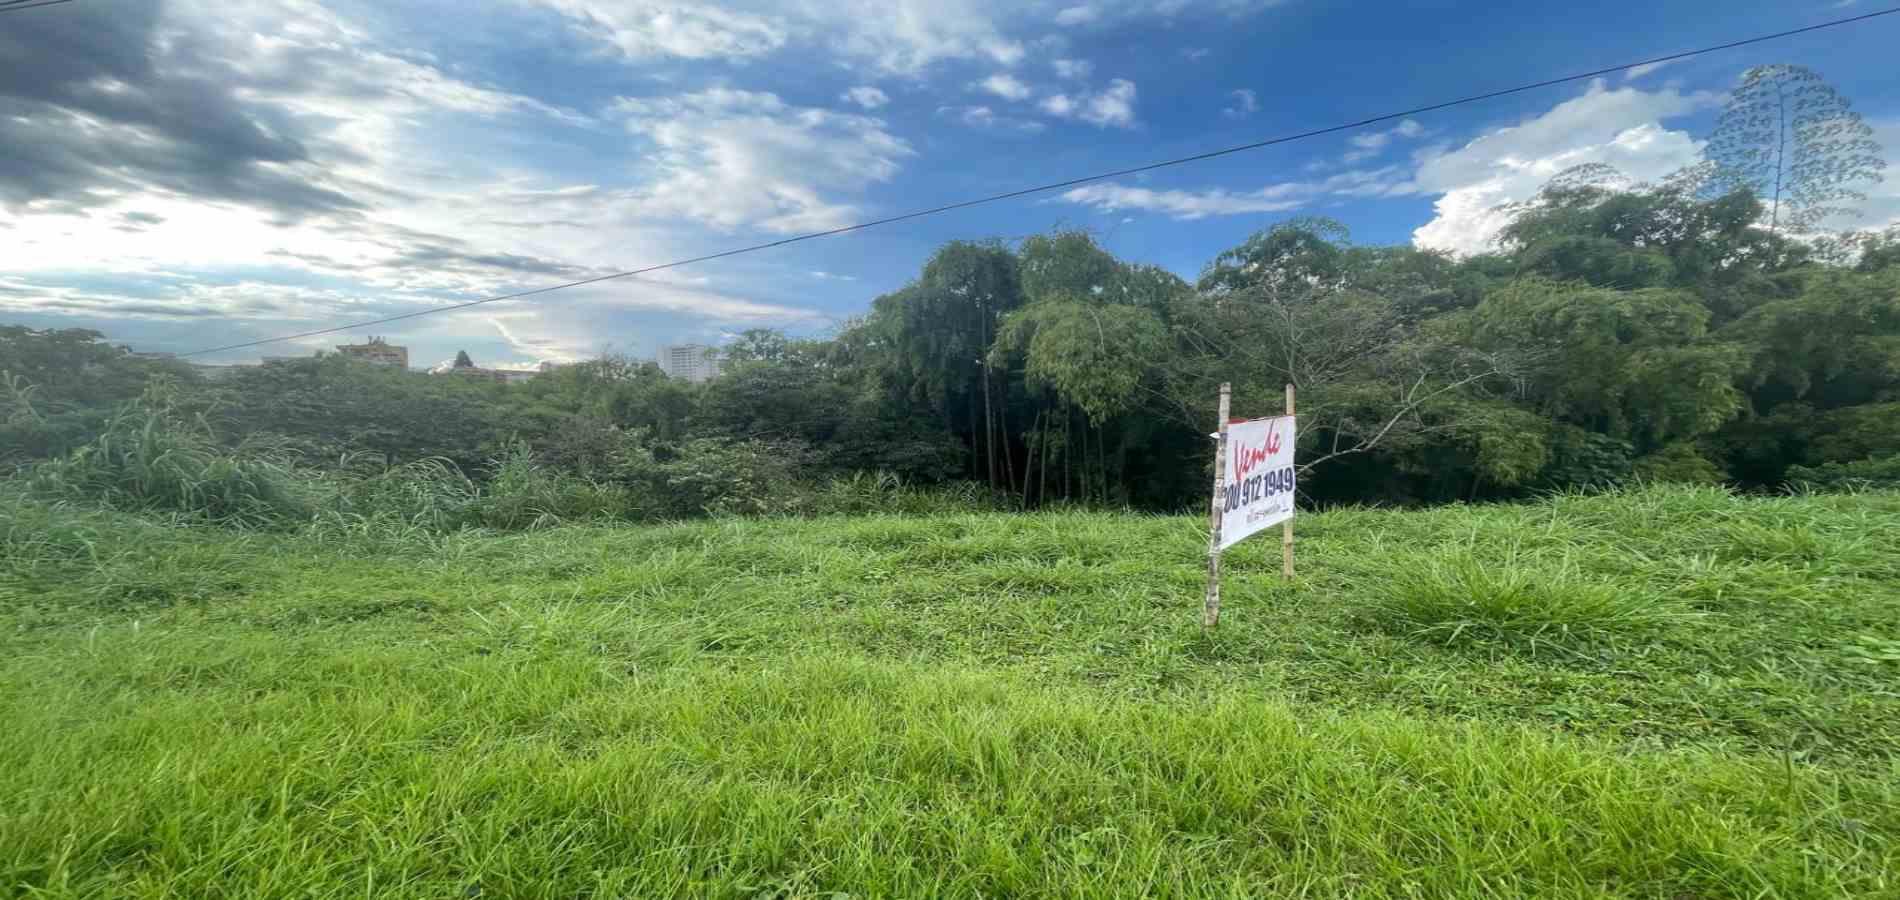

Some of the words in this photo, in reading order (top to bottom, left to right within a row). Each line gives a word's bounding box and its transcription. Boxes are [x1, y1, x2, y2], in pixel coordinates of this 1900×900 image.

[1234, 420, 1280, 481] Vende
[1241, 475, 1262, 506] 912
[1264, 467, 1293, 498] 1949
